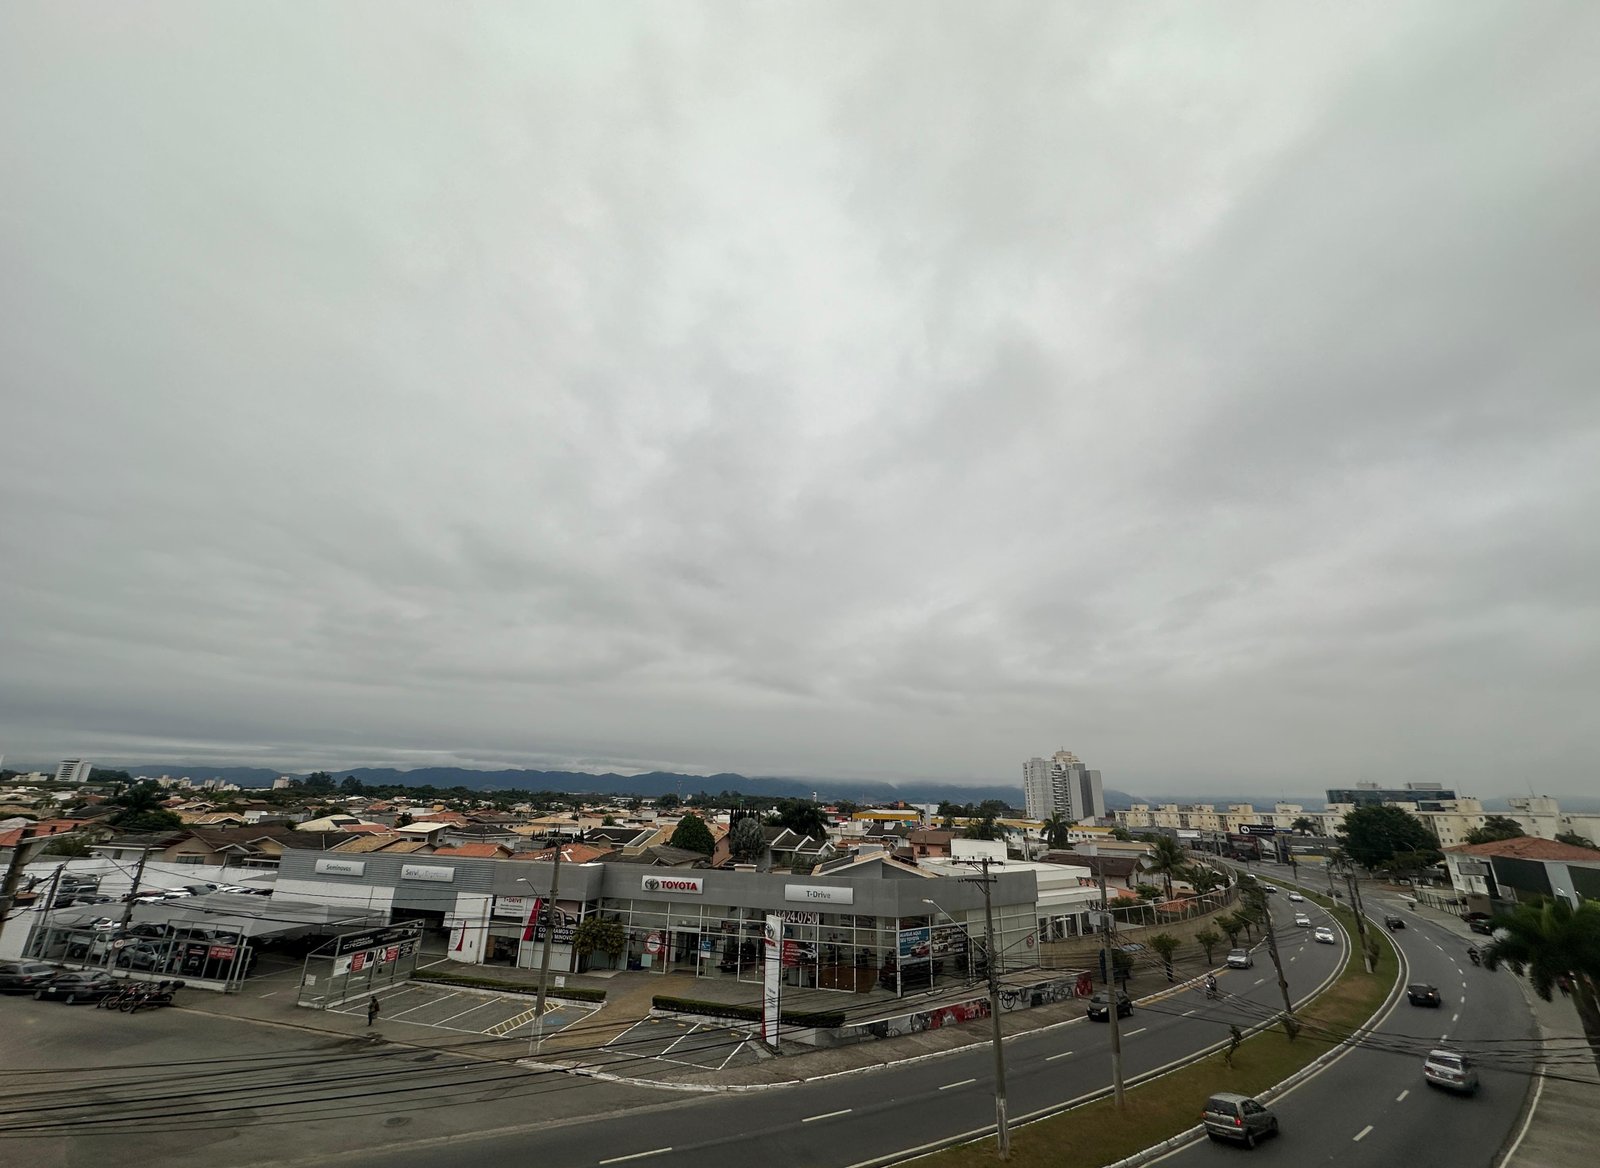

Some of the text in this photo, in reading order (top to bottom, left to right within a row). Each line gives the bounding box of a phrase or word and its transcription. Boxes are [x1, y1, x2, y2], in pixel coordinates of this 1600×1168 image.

[326, 864, 352, 872] Seminovos
[660, 880, 697, 891] TOYOTA
[806, 890, 832, 899] T-Drive
